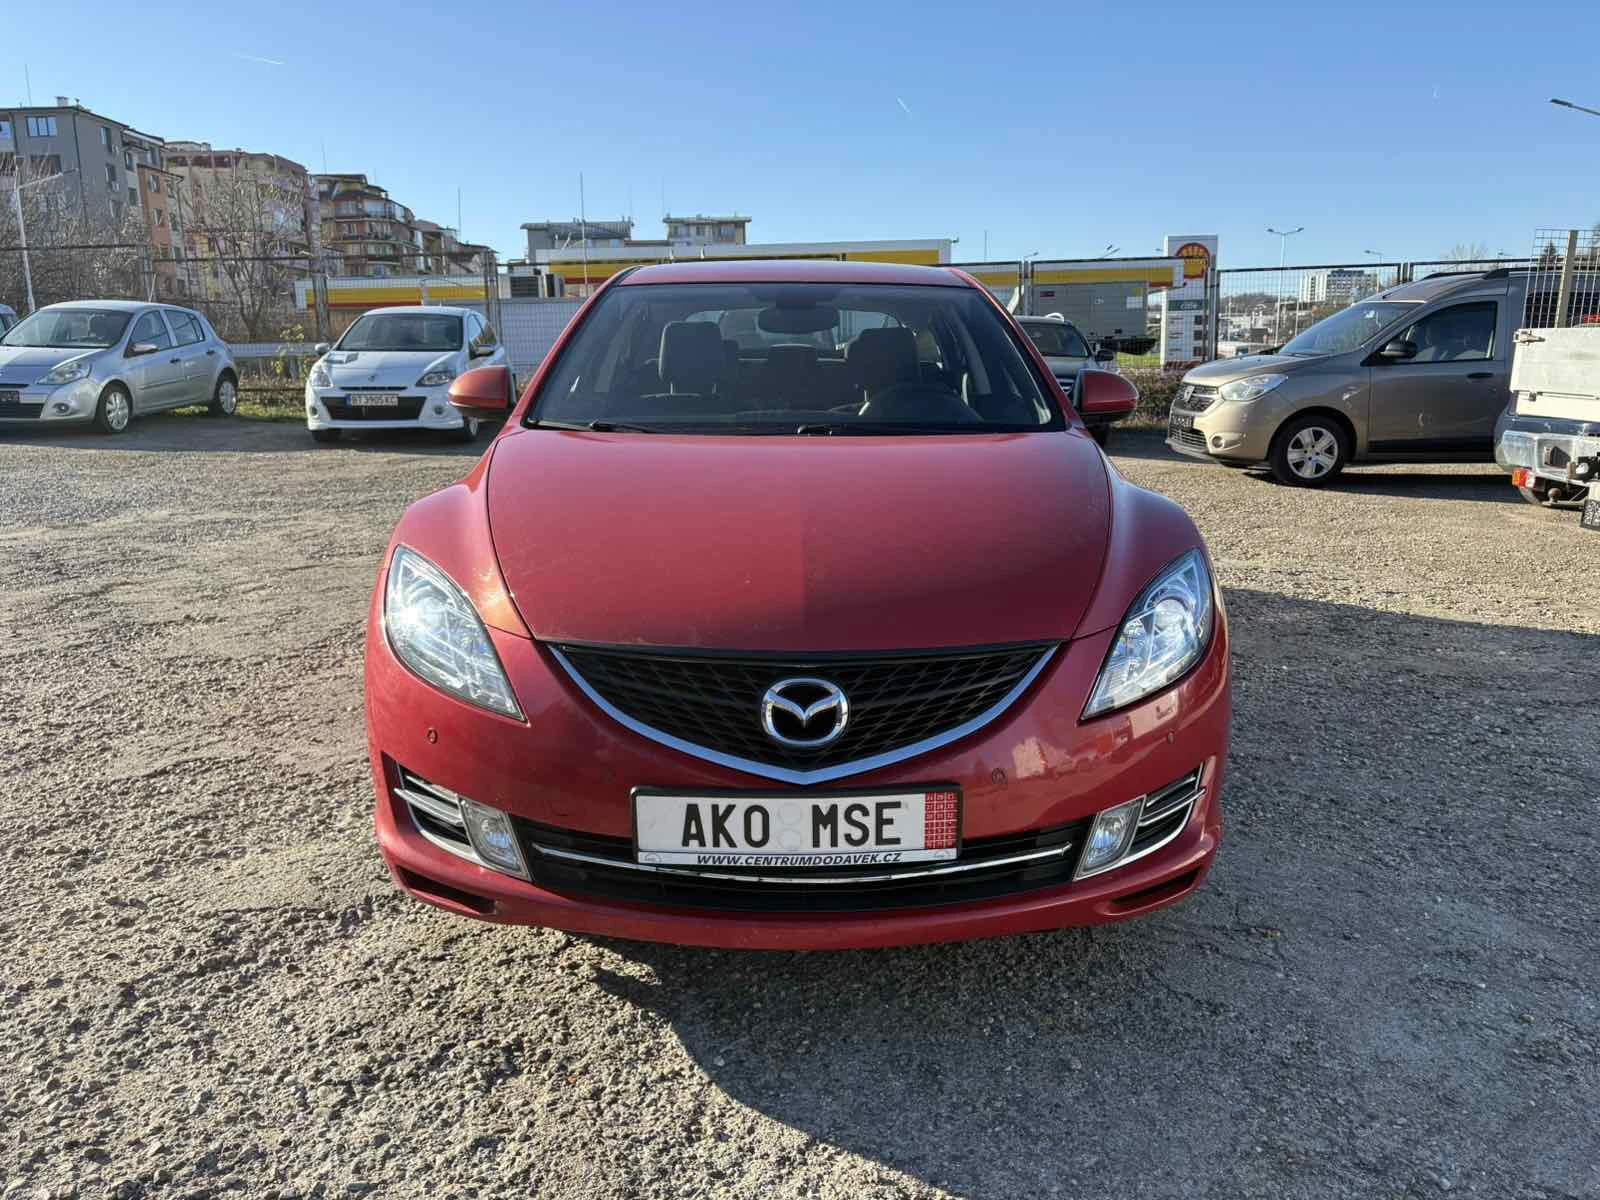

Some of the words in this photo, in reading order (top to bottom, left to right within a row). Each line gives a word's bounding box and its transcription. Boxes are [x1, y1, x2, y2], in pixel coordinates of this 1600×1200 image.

[681, 803, 769, 849] AKO
[811, 801, 902, 849] MSE
[696, 852, 901, 866] WWW.CENTRUMDODAVEK.CZ
